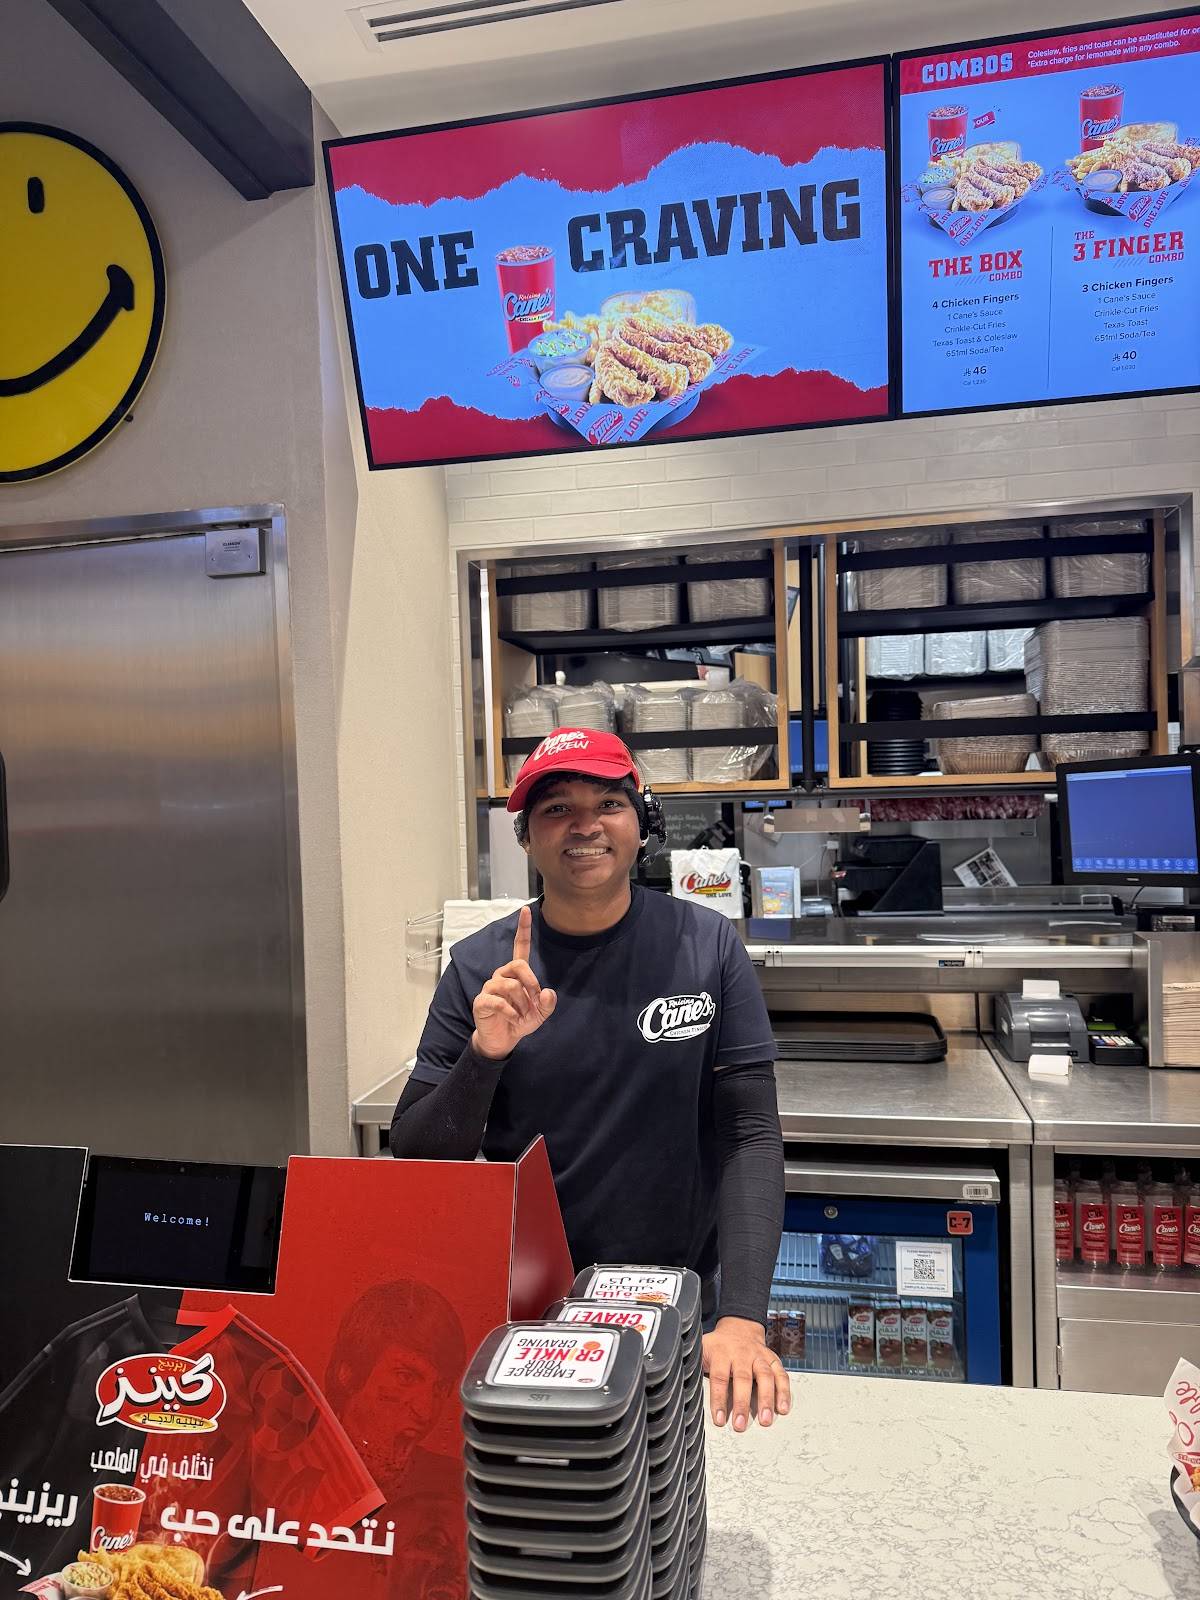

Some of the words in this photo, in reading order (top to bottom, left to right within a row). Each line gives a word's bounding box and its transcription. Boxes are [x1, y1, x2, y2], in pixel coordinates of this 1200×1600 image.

[1028, 48, 1061, 59] Coleslaw,
[1062, 45, 1078, 54] fries
[1079, 42, 1093, 51] and
[1094, 40, 1112, 49] toast
[1113, 38, 1126, 46] can
[1128, 35, 1137, 44] be
[1138, 30, 1179, 42] substituted
[1180, 28, 1190, 37] for
[1049, 55, 1074, 66] charge
[1075, 53, 1085, 62] for
[1086, 48, 1121, 60] lemonade
[1122, 45, 1138, 54] with
[1139, 43, 1152, 53] any
[1154, 40, 1180, 50] combo.
[922, 52, 1013, 84] COMBOS
[354, 230, 480, 300] ONE
[567, 178, 862, 273] CRAVING
[1075, 230, 1094, 240] THE
[1073, 243, 1086, 261] 3
[1093, 231, 1184, 259] FINGER
[929, 256, 973, 278] THE
[979, 250, 1023, 272] BOX
[1149, 252, 1184, 263] COMBO
[989, 271, 1023, 281] COMBO
[1082, 284, 1088, 292] 3
[1091, 281, 1132, 292] Chicken
[1135, 276, 1174, 287] Fingers
[503, 288, 553, 321] Cane's
[932, 301, 938, 309] 4
[941, 298, 980, 309] Chicken
[983, 293, 1020, 304] Fingers
[1103, 295, 1130, 304] Cane's
[1131, 292, 1156, 301] Sauce
[952, 311, 978, 320] Cane's
[979, 309, 1004, 317] Sauce
[1094, 306, 1138, 317] Crinkle-Cut
[1139, 304, 1159, 313] Fries
[944, 323, 986, 334] Crinkle-Cut
[988, 321, 1007, 329] Fries
[1127, 319, 1148, 327] Toast
[956, 337, 975, 345] Toast
[984, 333, 1018, 342] Coleslaw
[1119, 330, 1156, 340] Soda/Tea
[969, 345, 1004, 355] Soda/Tea
[1122, 350, 1137, 360] 40
[972, 365, 987, 375] 46
[624, 408, 649, 437] LOVE
[533, 731, 588, 760] Cane's
[547, 741, 590, 755] CREW
[681, 871, 731, 894] Cane's
[668, 997, 695, 1009] Raising
[642, 992, 714, 1040] Cane's
[144, 1212, 210, 1227] Welcome!
[949, 1217, 970, 1228] C-7
[572, 1311, 643, 1327] CRAVE!
[517, 1338, 578, 1348] CRAVING
[514, 1347, 605, 1362] CRINKLE
[158, 1358, 187, 1373] ريزينج
[525, 1360, 562, 1369] YOUR
[504, 1367, 576, 1378] EMBRACE
[102, 1355, 214, 1418] كينز
[142, 1413, 174, 1424] الدجاج
[90, 1447, 138, 1474] الملعب
[140, 1453, 168, 1483] في
[172, 1452, 214, 1480] نختلف
[160, 1506, 220, 1543] حب
[227, 1507, 300, 1545] على
[91, 1526, 136, 1551] Cane's
[306, 1518, 395, 1556] نتحد
